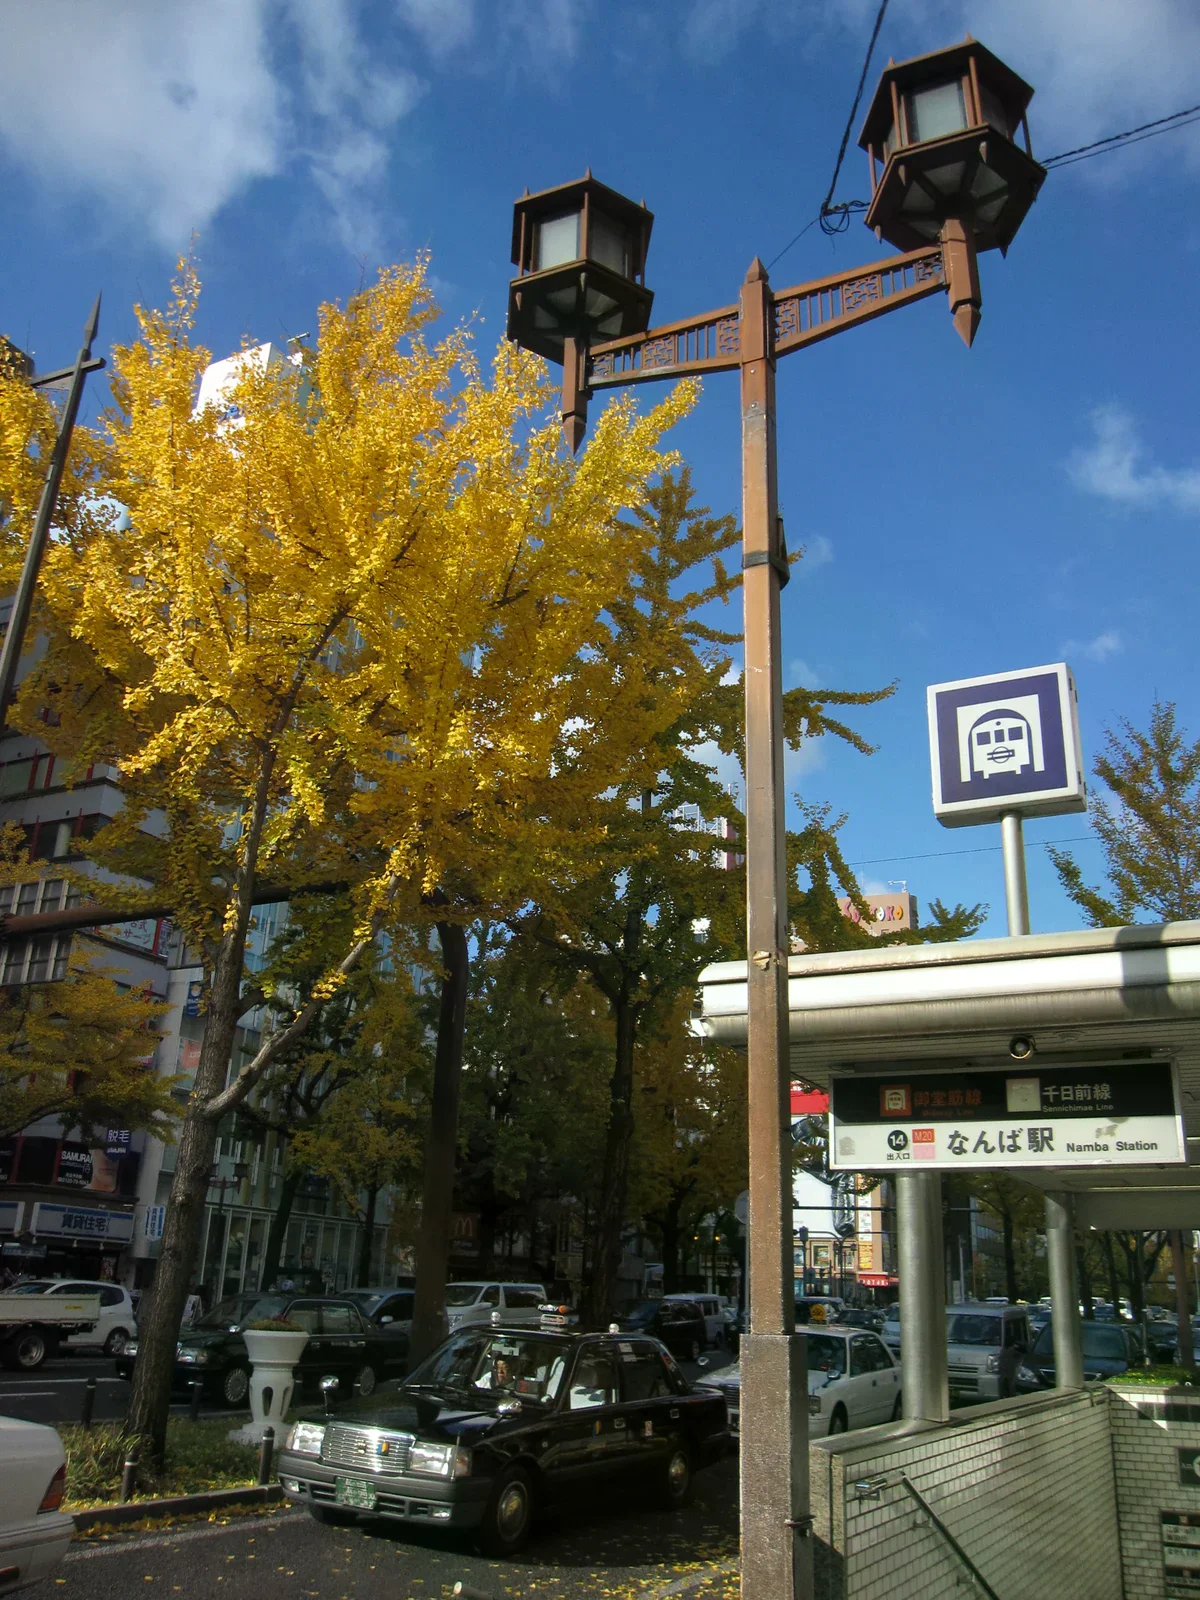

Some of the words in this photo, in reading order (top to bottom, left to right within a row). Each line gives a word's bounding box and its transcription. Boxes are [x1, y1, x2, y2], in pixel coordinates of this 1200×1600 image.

[913, 1088, 982, 1107] 御堂筋線
[1042, 1083, 1112, 1103] 千日前線
[1042, 1104, 1094, 1113] Sennichimae
[1095, 1103, 1115, 1111] Line
[889, 1133, 906, 1147] 14
[914, 1130, 934, 1142] M20
[947, 1127, 1054, 1155] なんば駅
[1066, 1141, 1109, 1153] Namba
[1115, 1140, 1158, 1152] Station
[61, 1150, 93, 1163] SAMURAI
[886, 1152, 911, 1161] 出入口
[61, 1213, 106, 1233] 賃貸住宅
